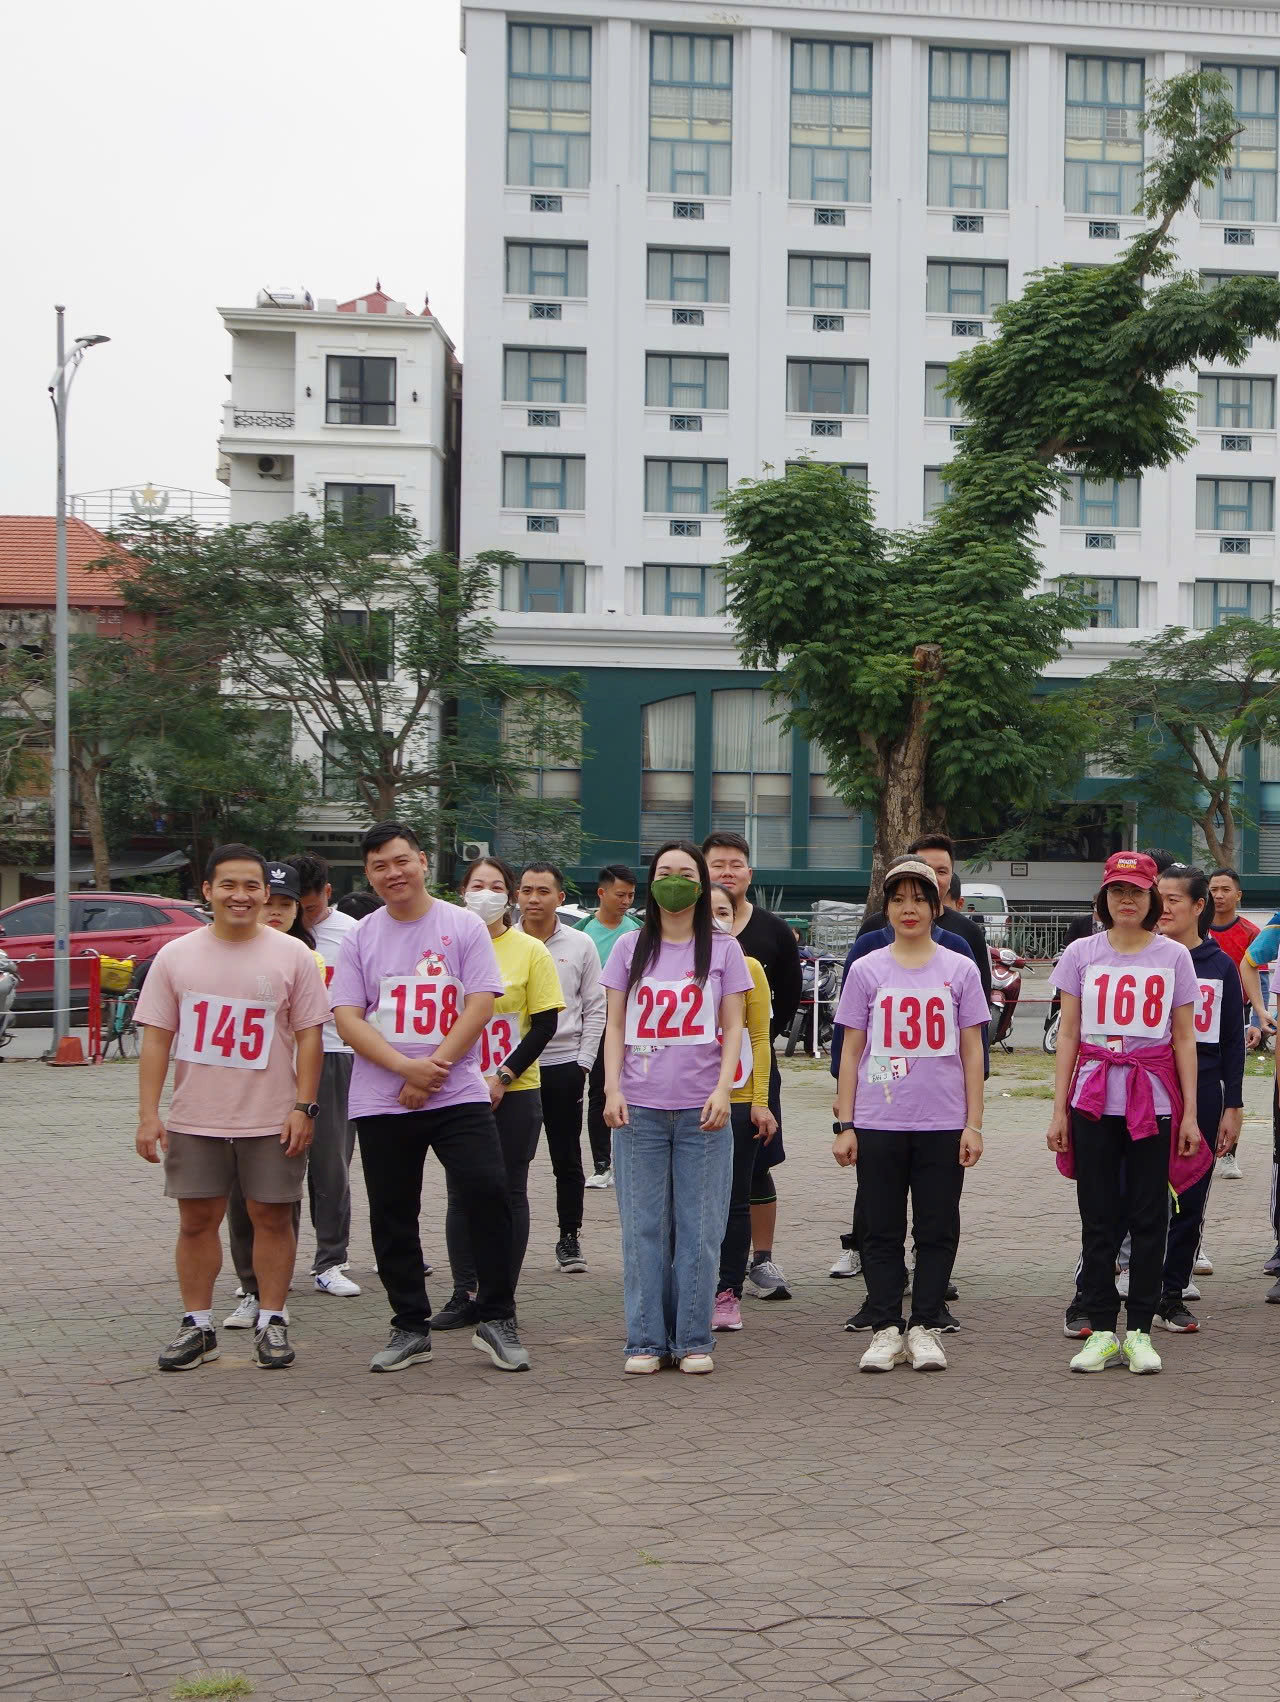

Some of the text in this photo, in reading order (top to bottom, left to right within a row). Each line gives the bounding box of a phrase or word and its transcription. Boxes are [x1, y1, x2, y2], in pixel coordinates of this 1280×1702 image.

[391, 984, 459, 1037] 158
[637, 984, 705, 1039] 222
[880, 995, 946, 1050] 136
[1094, 973, 1164, 1029] 168
[192, 1000, 266, 1061] 145
